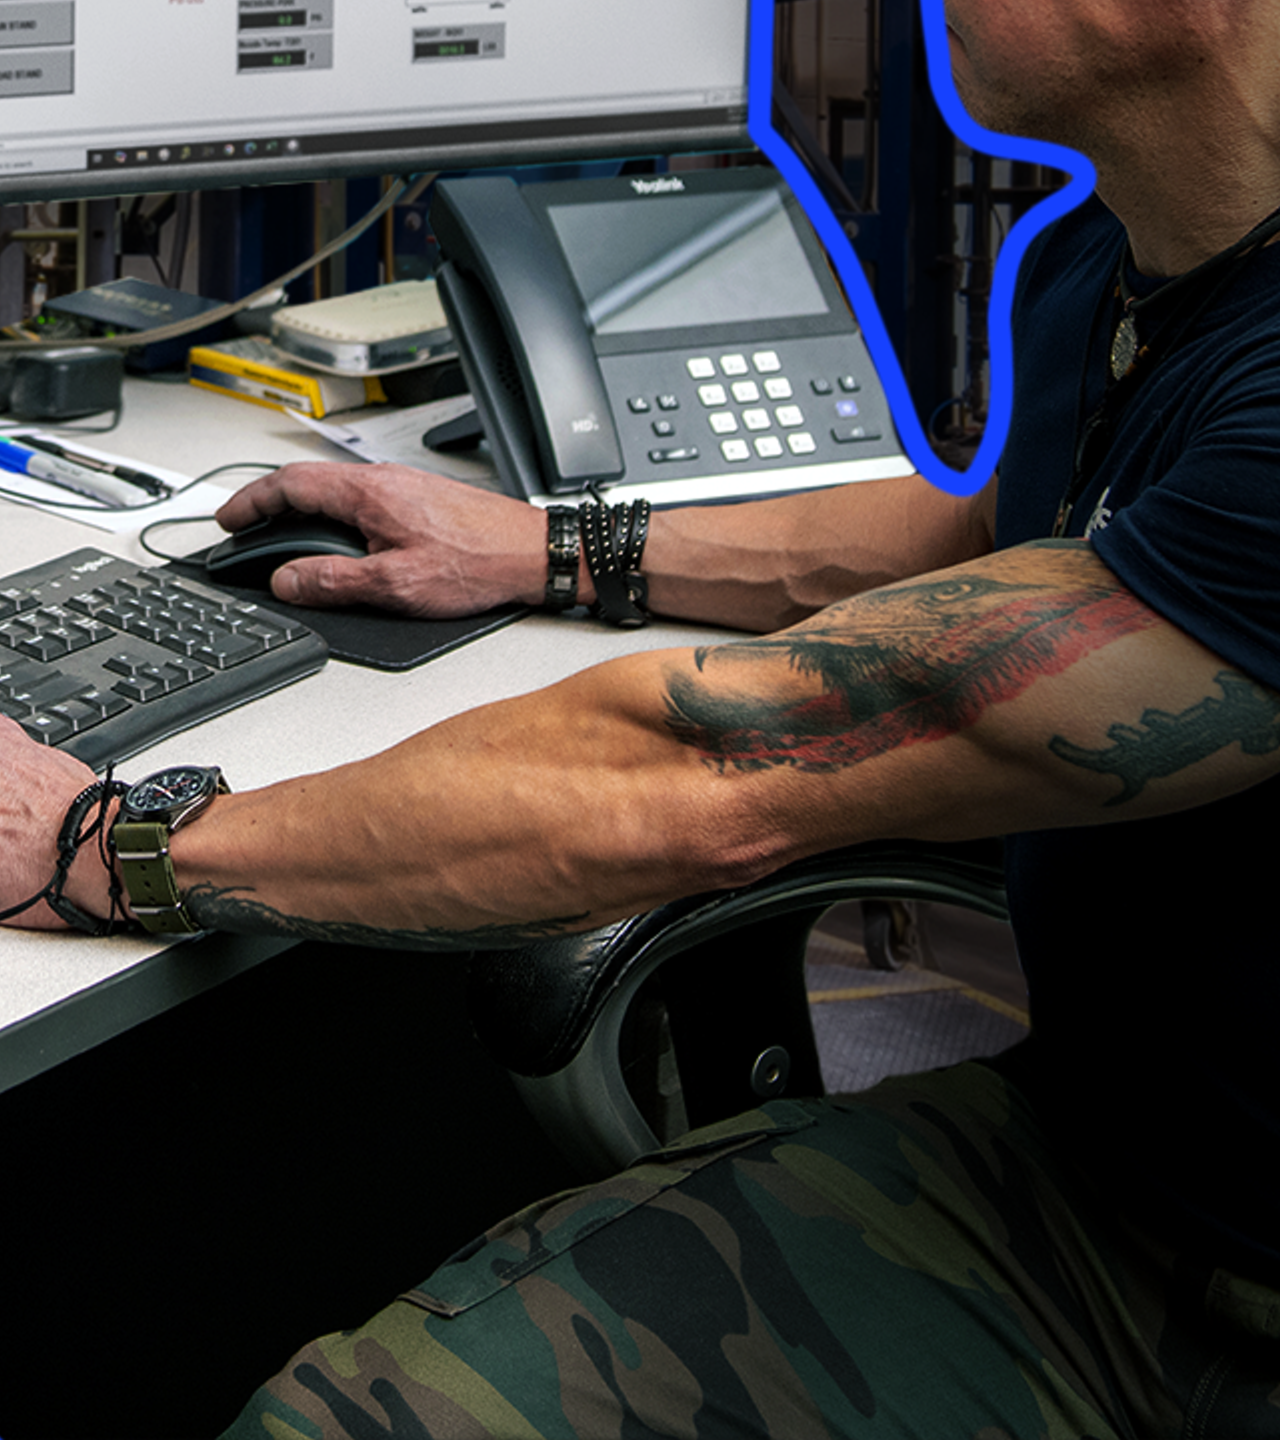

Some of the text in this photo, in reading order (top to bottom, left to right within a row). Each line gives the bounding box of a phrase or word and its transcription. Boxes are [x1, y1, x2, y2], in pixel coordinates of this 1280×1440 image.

[9, 20, 37, 31] STAND
[15, 69, 42, 80] STAND
[631, 177, 684, 193] Yealink
